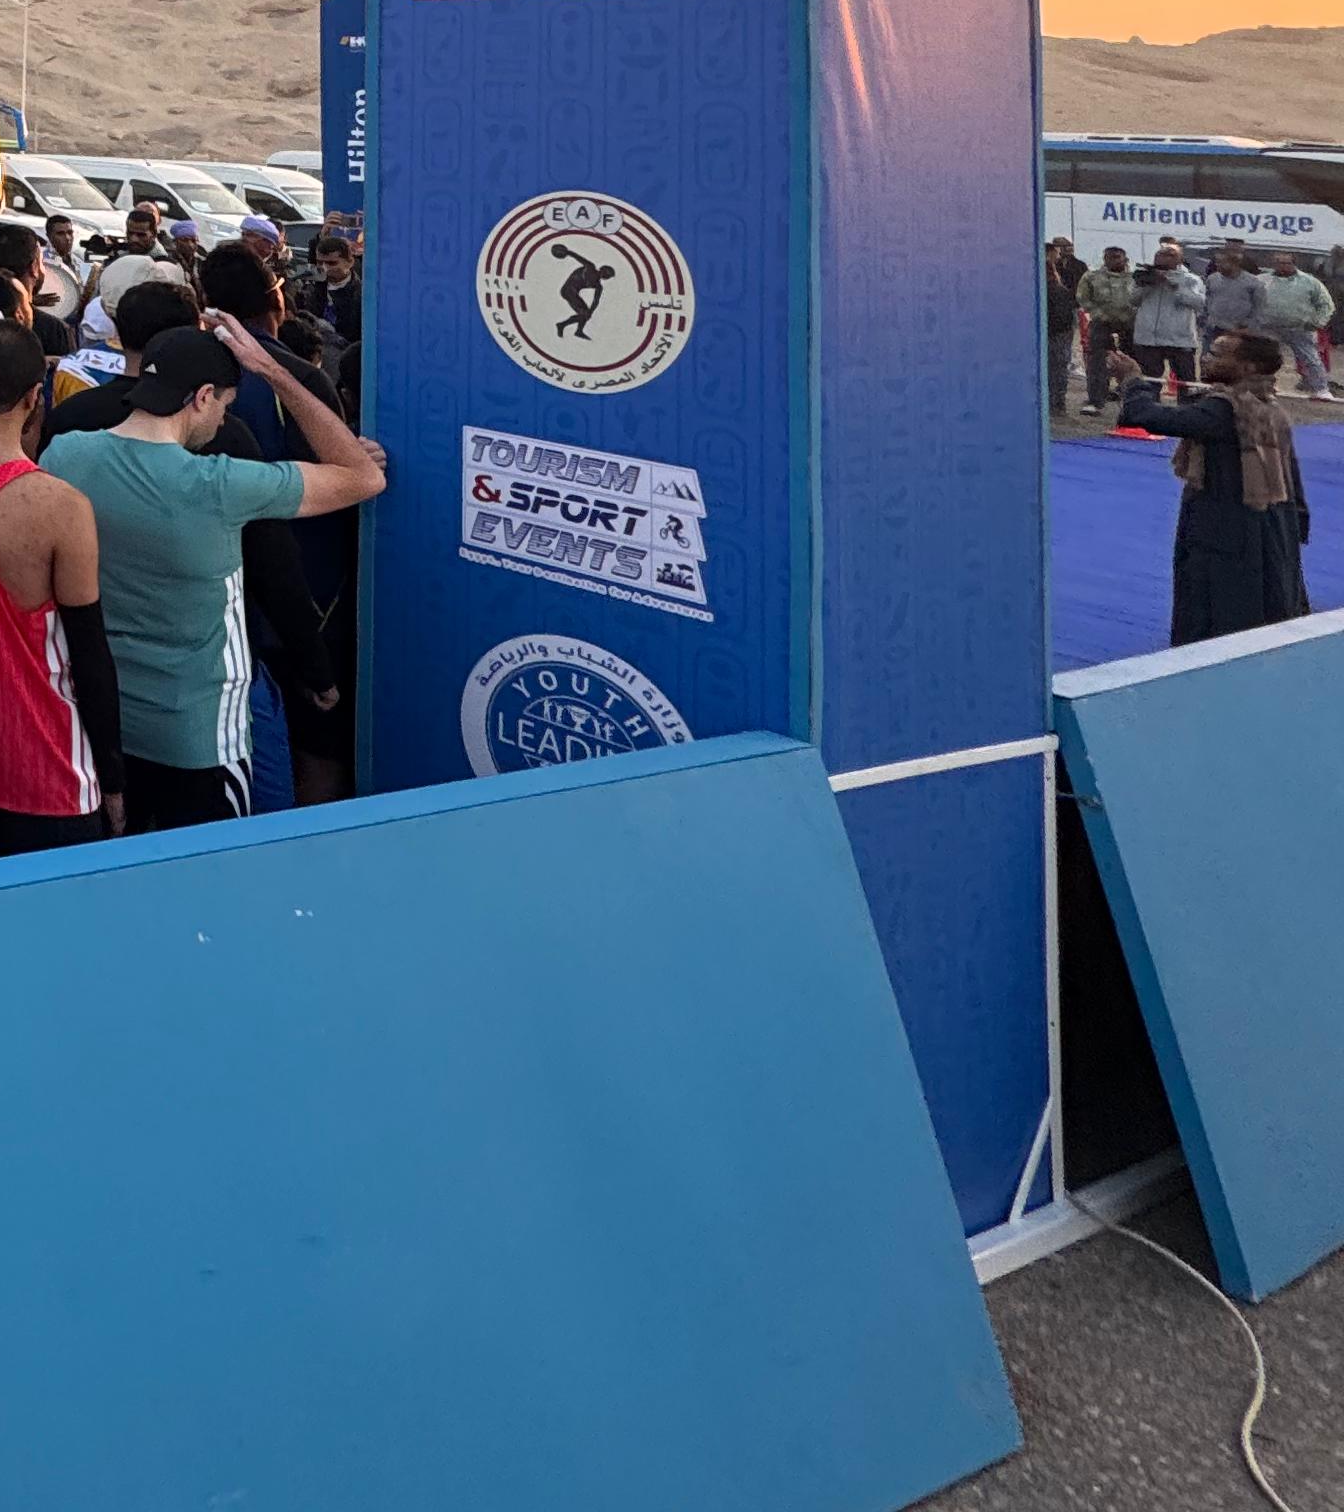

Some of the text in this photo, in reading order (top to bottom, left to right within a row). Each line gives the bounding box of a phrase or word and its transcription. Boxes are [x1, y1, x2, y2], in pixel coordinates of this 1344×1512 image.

[1102, 201, 1314, 236] Alfriend voyage
[470, 434, 641, 495] TOURISM
[472, 474, 649, 537] & SPORT
[470, 511, 648, 581] EVENTS
[479, 641, 686, 744] وزارة الشباب والرياضة
[512, 669, 650, 737] YOUTH
